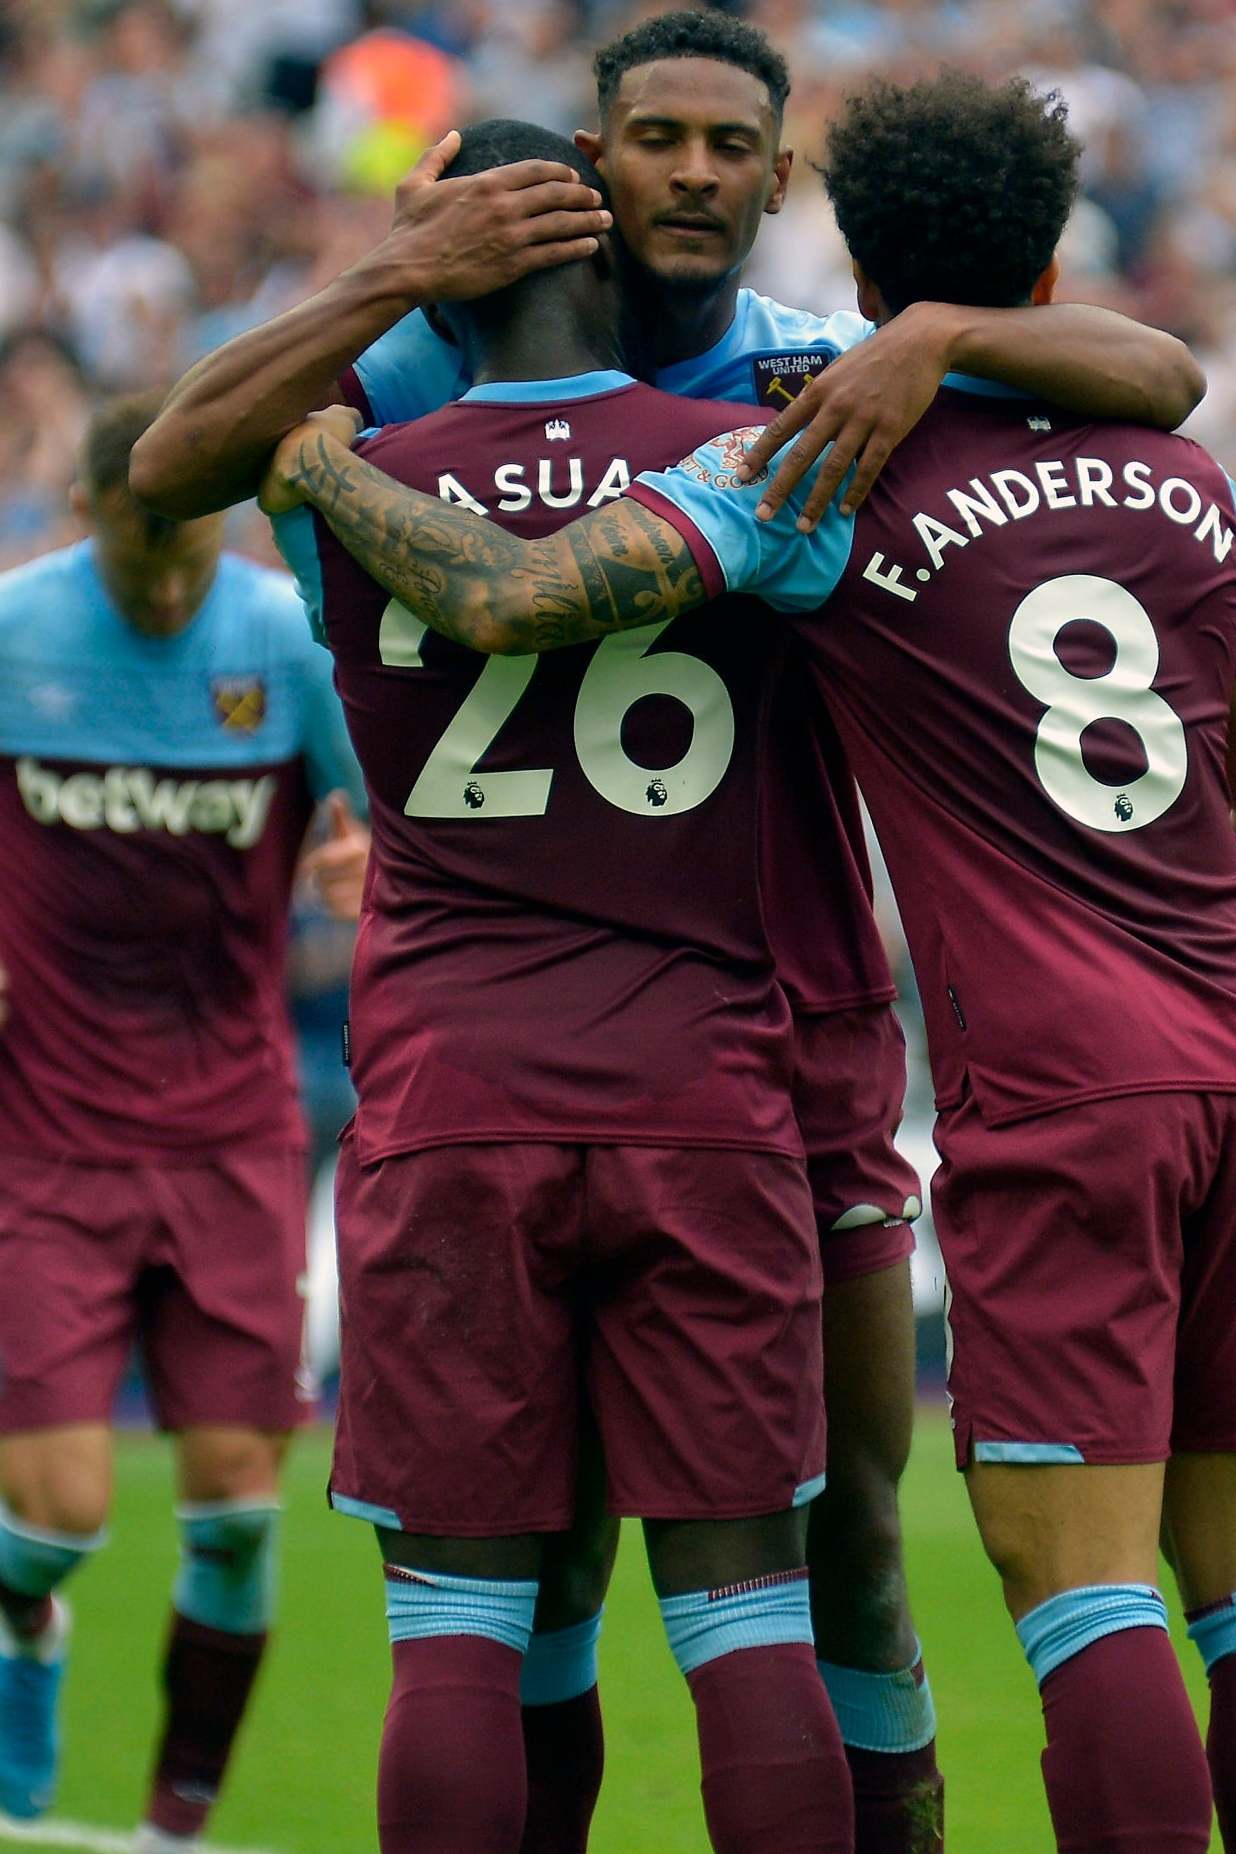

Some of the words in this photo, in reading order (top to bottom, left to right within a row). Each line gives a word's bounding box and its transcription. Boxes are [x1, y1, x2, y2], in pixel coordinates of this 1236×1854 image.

[758, 357, 791, 370] WEST
[792, 355, 823, 366] HAM
[773, 365, 810, 375] UNITED
[862, 457, 1234, 602] F.ANDERSON
[379, 597, 735, 818] 26
[1008, 574, 1188, 833] 8
[16, 756, 277, 849] betway
